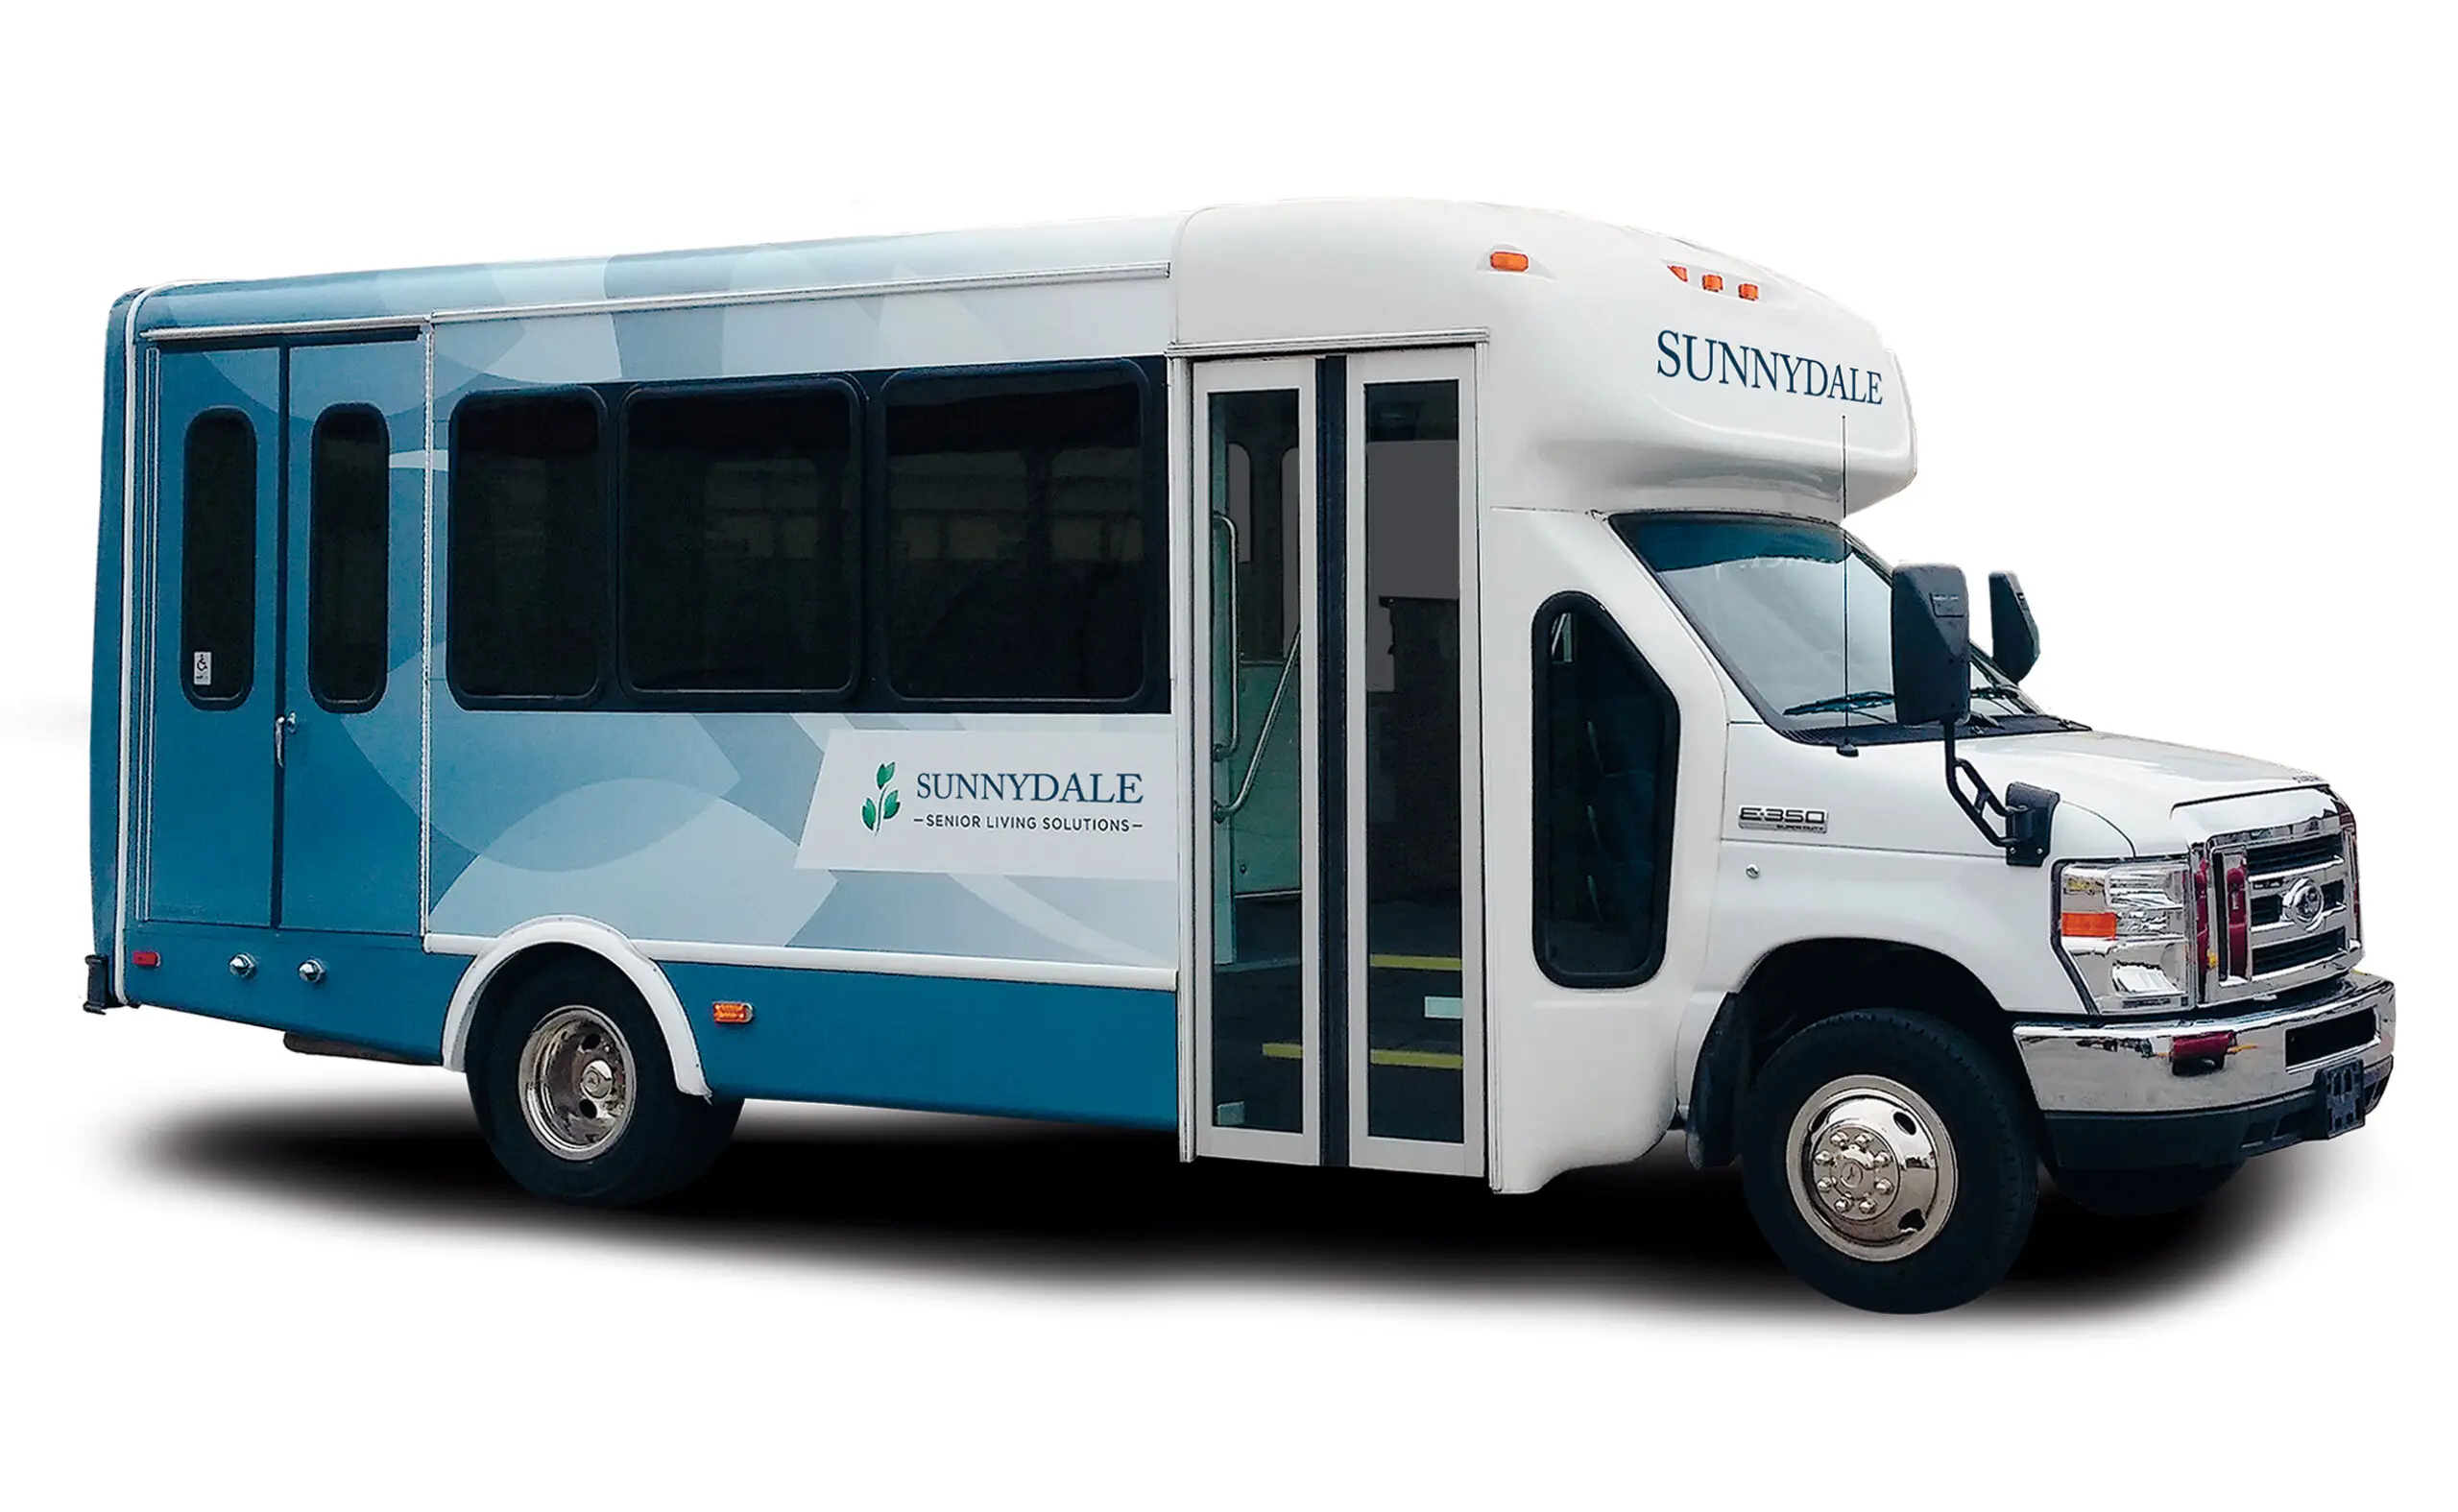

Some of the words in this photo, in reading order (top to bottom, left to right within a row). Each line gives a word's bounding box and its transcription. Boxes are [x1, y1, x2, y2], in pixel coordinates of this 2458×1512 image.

[1657, 329, 1883, 405] SUNNYDALE
[917, 772, 1144, 804] SUNNYDALE
[926, 813, 981, 828] SENIOR
[986, 816, 1037, 830] LIVING
[1042, 816, 1130, 832] SOLUTIONS
